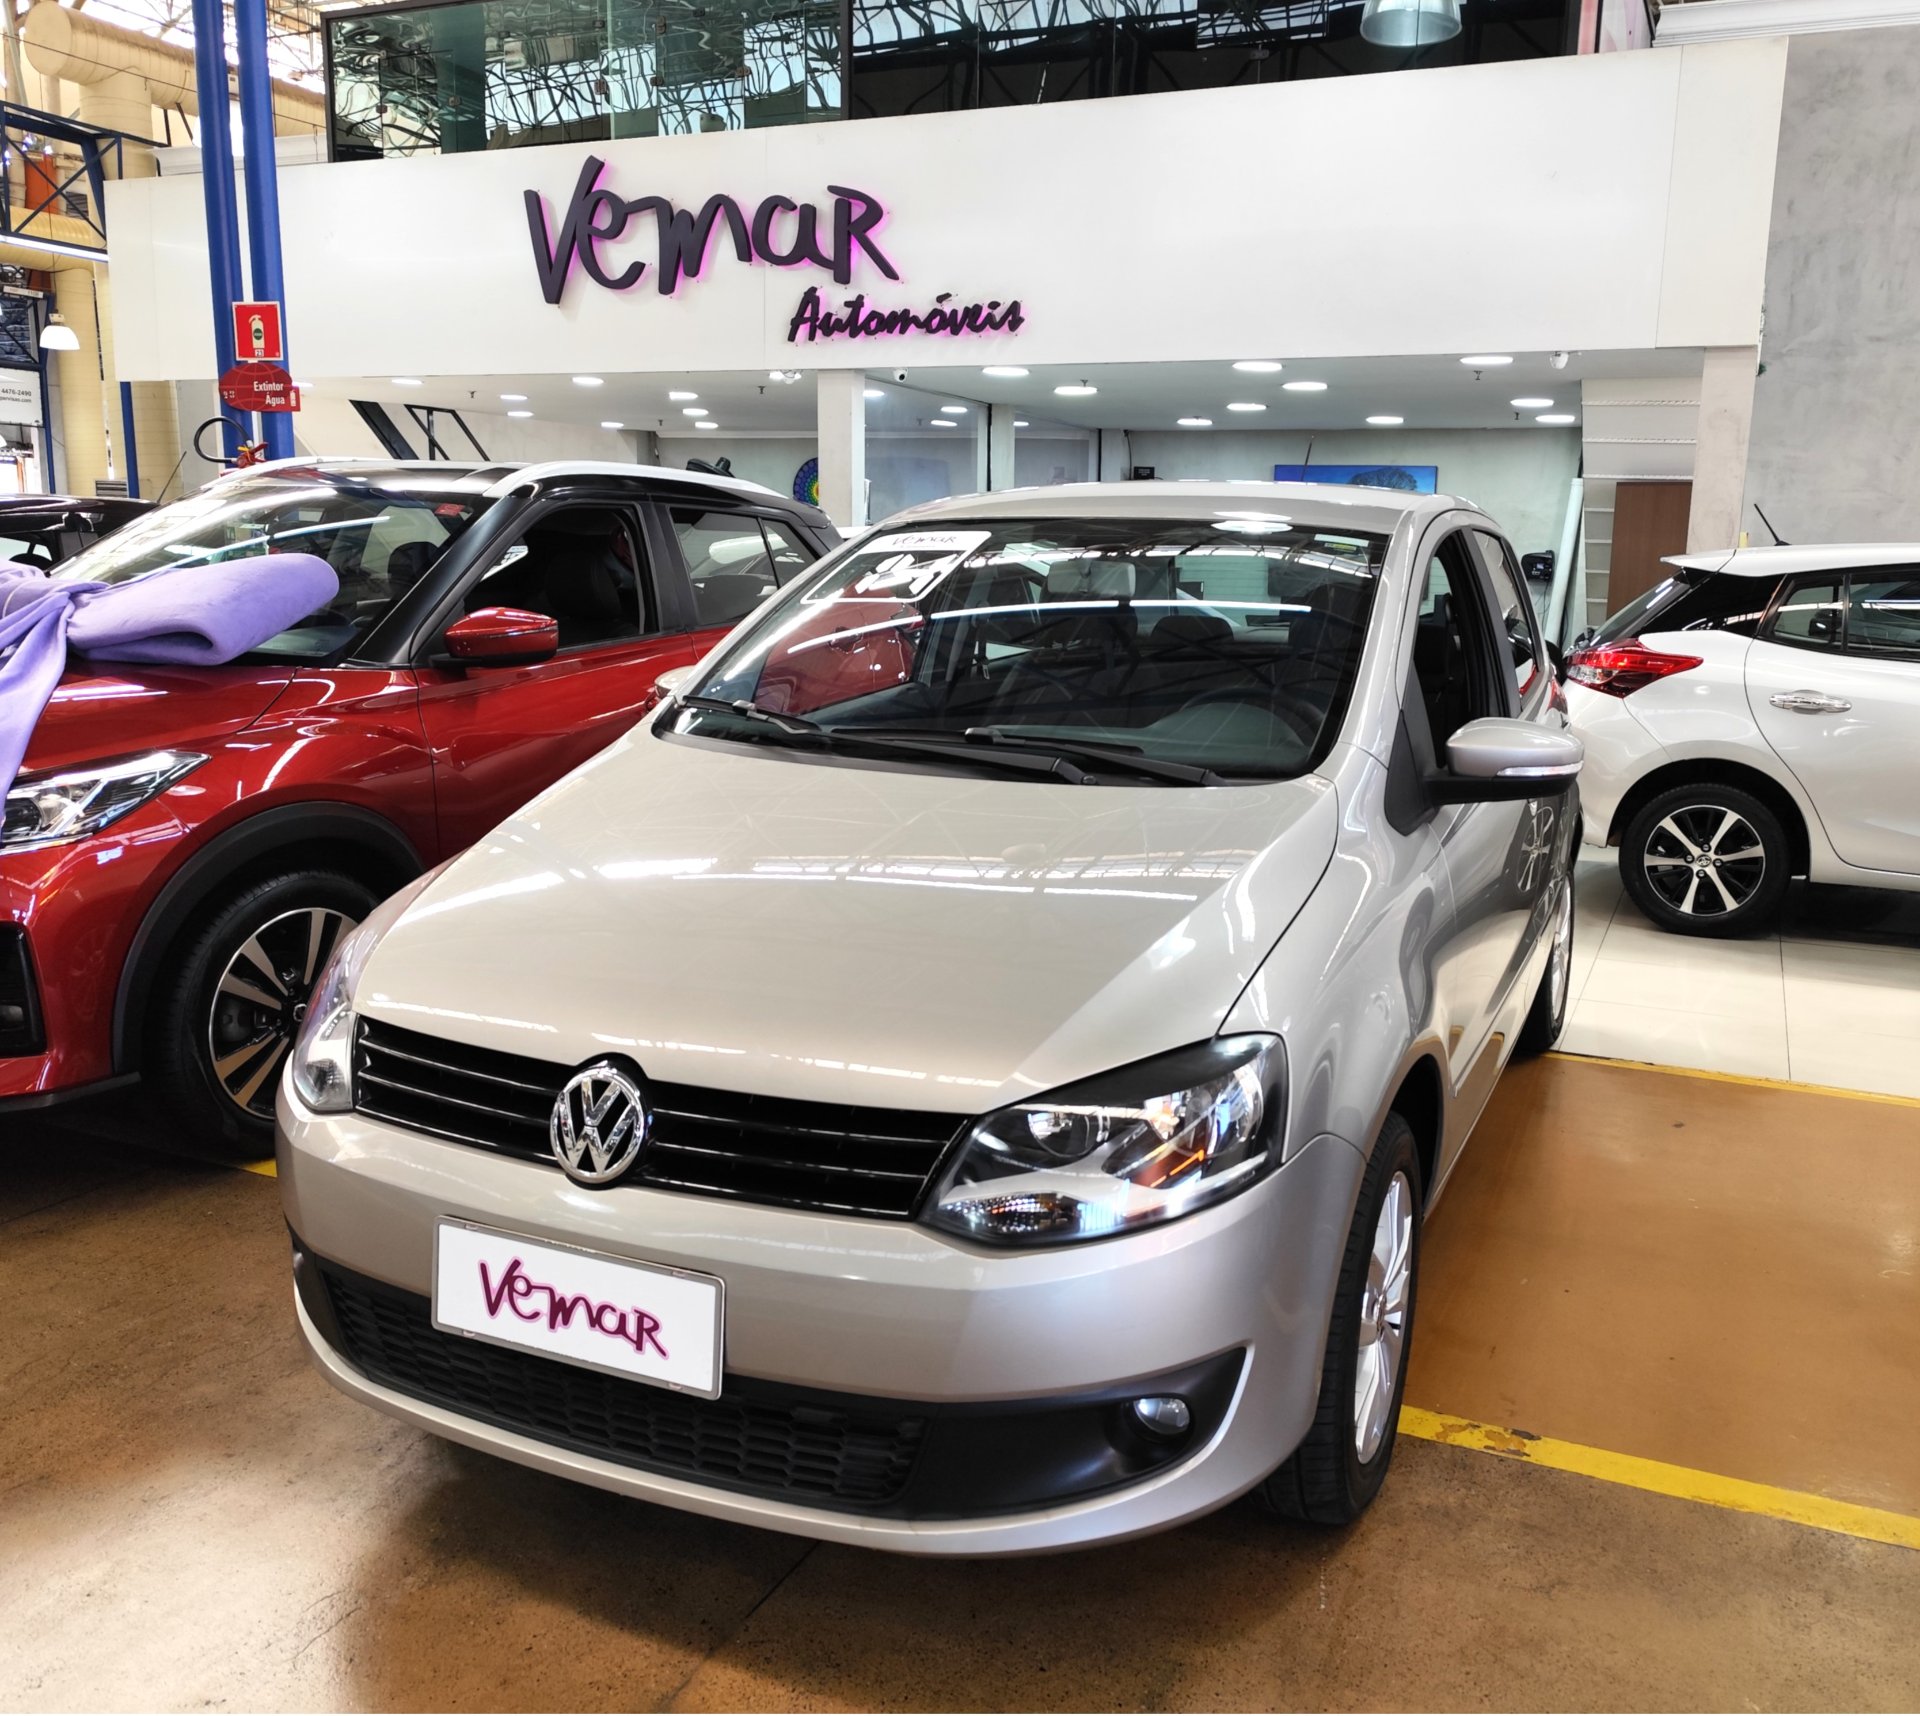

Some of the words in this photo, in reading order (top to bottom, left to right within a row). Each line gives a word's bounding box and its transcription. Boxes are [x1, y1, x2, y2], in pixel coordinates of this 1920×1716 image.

[787, 286, 1025, 343] Automóveis
[253, 381, 284, 392] Extintor
[265, 392, 285, 406] Água
